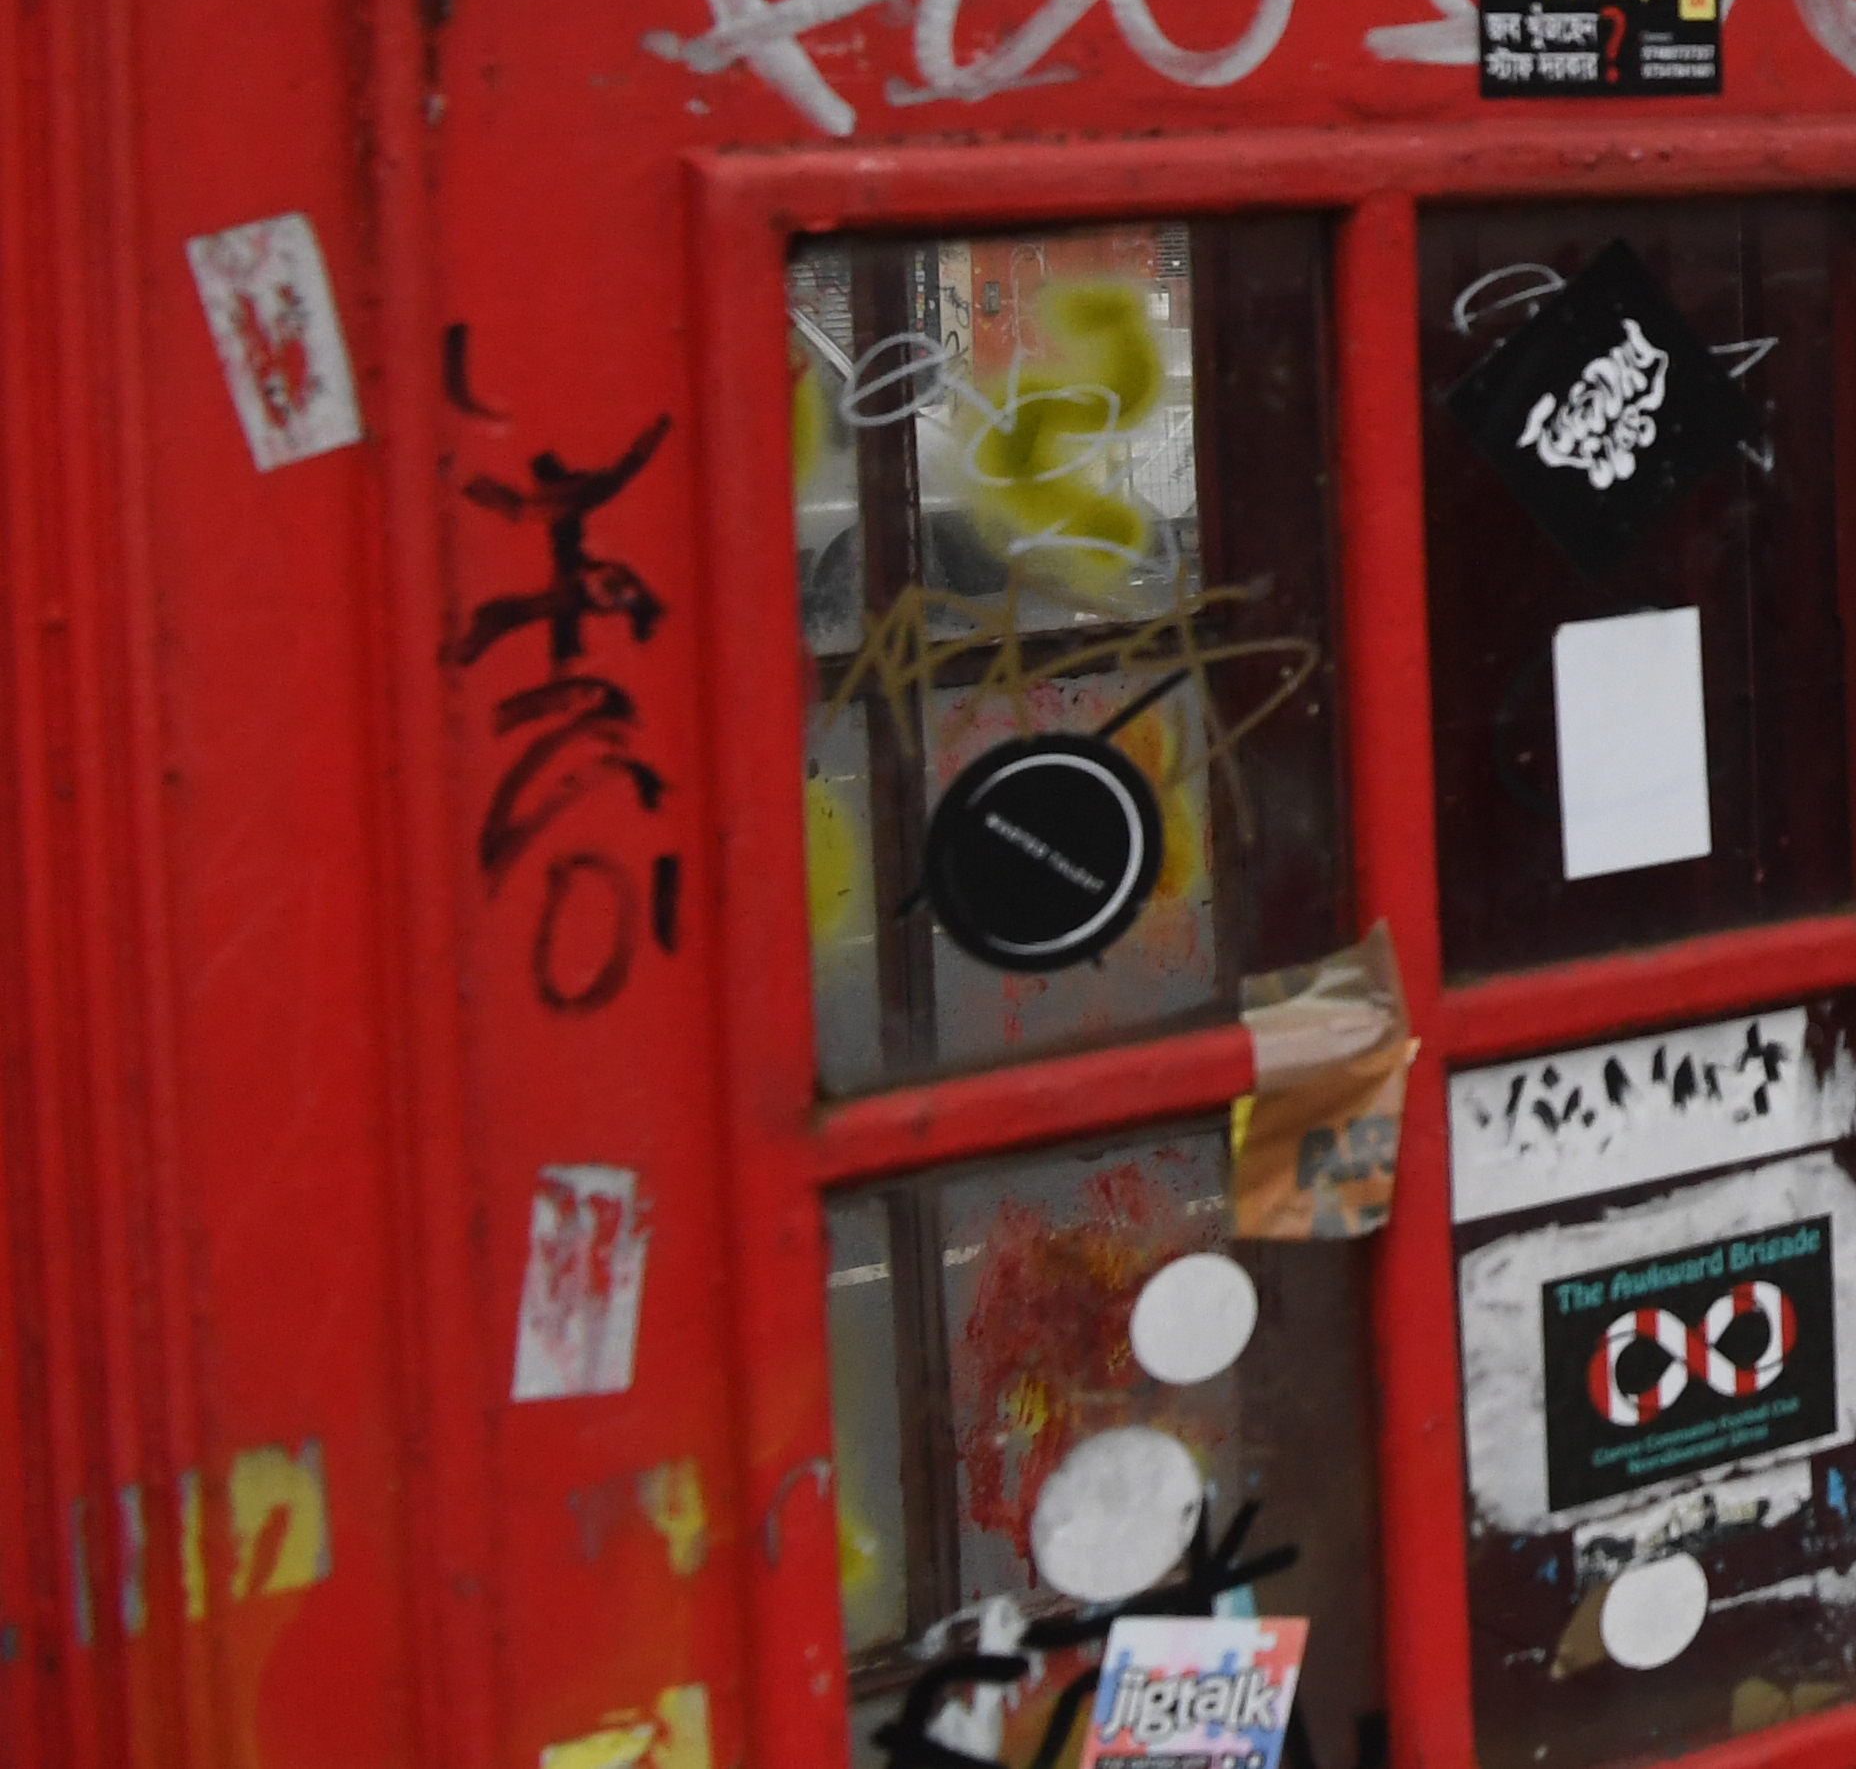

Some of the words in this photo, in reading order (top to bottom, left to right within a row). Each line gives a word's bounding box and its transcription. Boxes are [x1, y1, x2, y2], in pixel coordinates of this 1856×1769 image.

[1554, 1281, 1605, 1316] The
[1609, 1246, 1725, 1302] Awkward
[1728, 1226, 1821, 1273] Brigade
[1100, 1666, 1277, 1744] jigtalk
